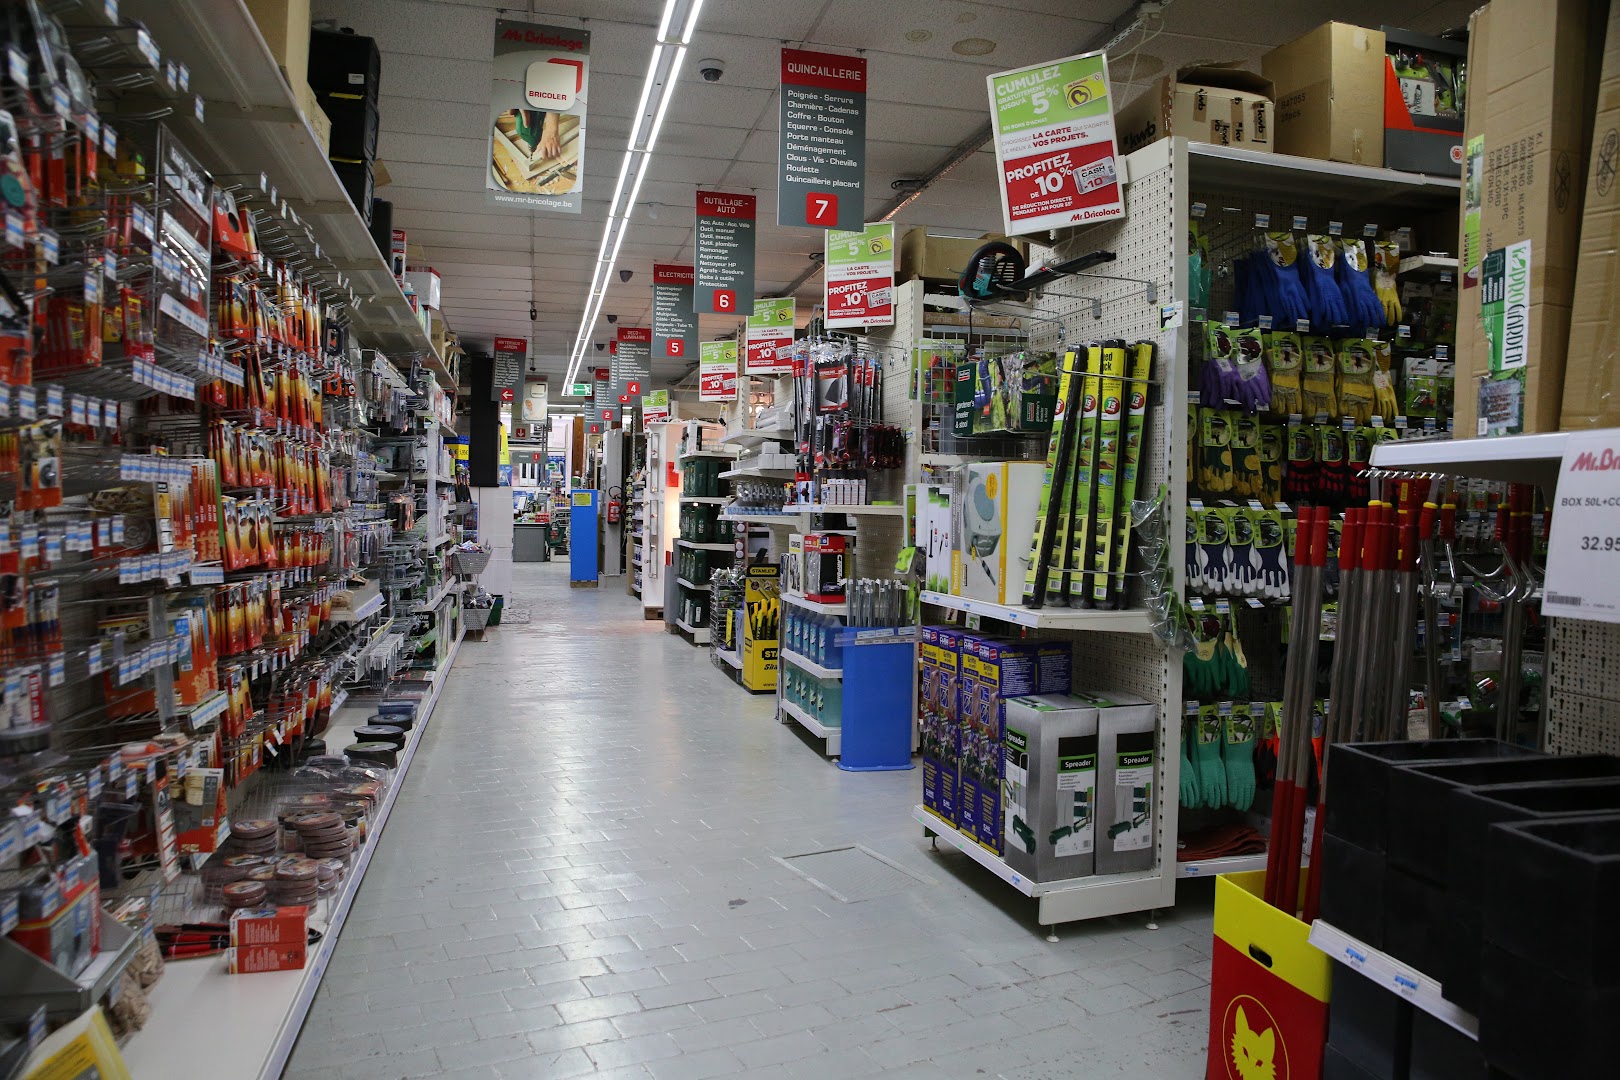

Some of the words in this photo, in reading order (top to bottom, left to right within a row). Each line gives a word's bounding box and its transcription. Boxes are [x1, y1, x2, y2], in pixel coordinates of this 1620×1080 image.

[788, 63, 861, 80] QUINCAILLERIE
[997, 66, 1061, 96] CUMULEZ
[529, 90, 566, 100] BRICOLER
[788, 90, 818, 100] Poignée
[824, 94, 853, 104] Serrure
[998, 85, 1045, 104] GRATUITEMENT
[788, 101, 823, 110] Charnière
[829, 106, 858, 115] Cadenas
[788, 111, 811, 120] Coffre
[818, 114, 844, 124] Bouton
[787, 122, 817, 131] Equerre
[824, 126, 853, 135] Console
[1045, 127, 1071, 137] CARTE
[787, 132, 808, 141] Porte
[811, 136, 843, 144] manteau
[1051, 132, 1088, 144] PROJETS.
[787, 143, 846, 155] Déménagement
[787, 164, 819, 173] Roulette
[830, 158, 857, 167] Cheville
[1006, 152, 1071, 183] PROFITEZ
[1082, 166, 1105, 178] CASH
[786, 175, 830, 185] Quincaillerie
[833, 180, 859, 188] placard
[495, 195, 572, 207] www.mr-bricolage.be
[704, 197, 743, 206] OUTILLAGE
[1051, 196, 1072, 205] DIRECTE
[816, 200, 828, 218] 7
[1013, 208, 1036, 216] PENDANT
[829, 281, 867, 296] PROFITEZ
[720, 295, 729, 308] 6
[672, 343, 678, 352] 5
[749, 341, 776, 350] PROFITEZ
[957, 400, 974, 411] gardener's
[1562, 497, 1582, 506] BOX
[1582, 536, 1620, 552] 32.95
[1008, 732, 1025, 746] Spreader
[1065, 760, 1091, 769] Spreader
[1124, 756, 1150, 765] Spreader
